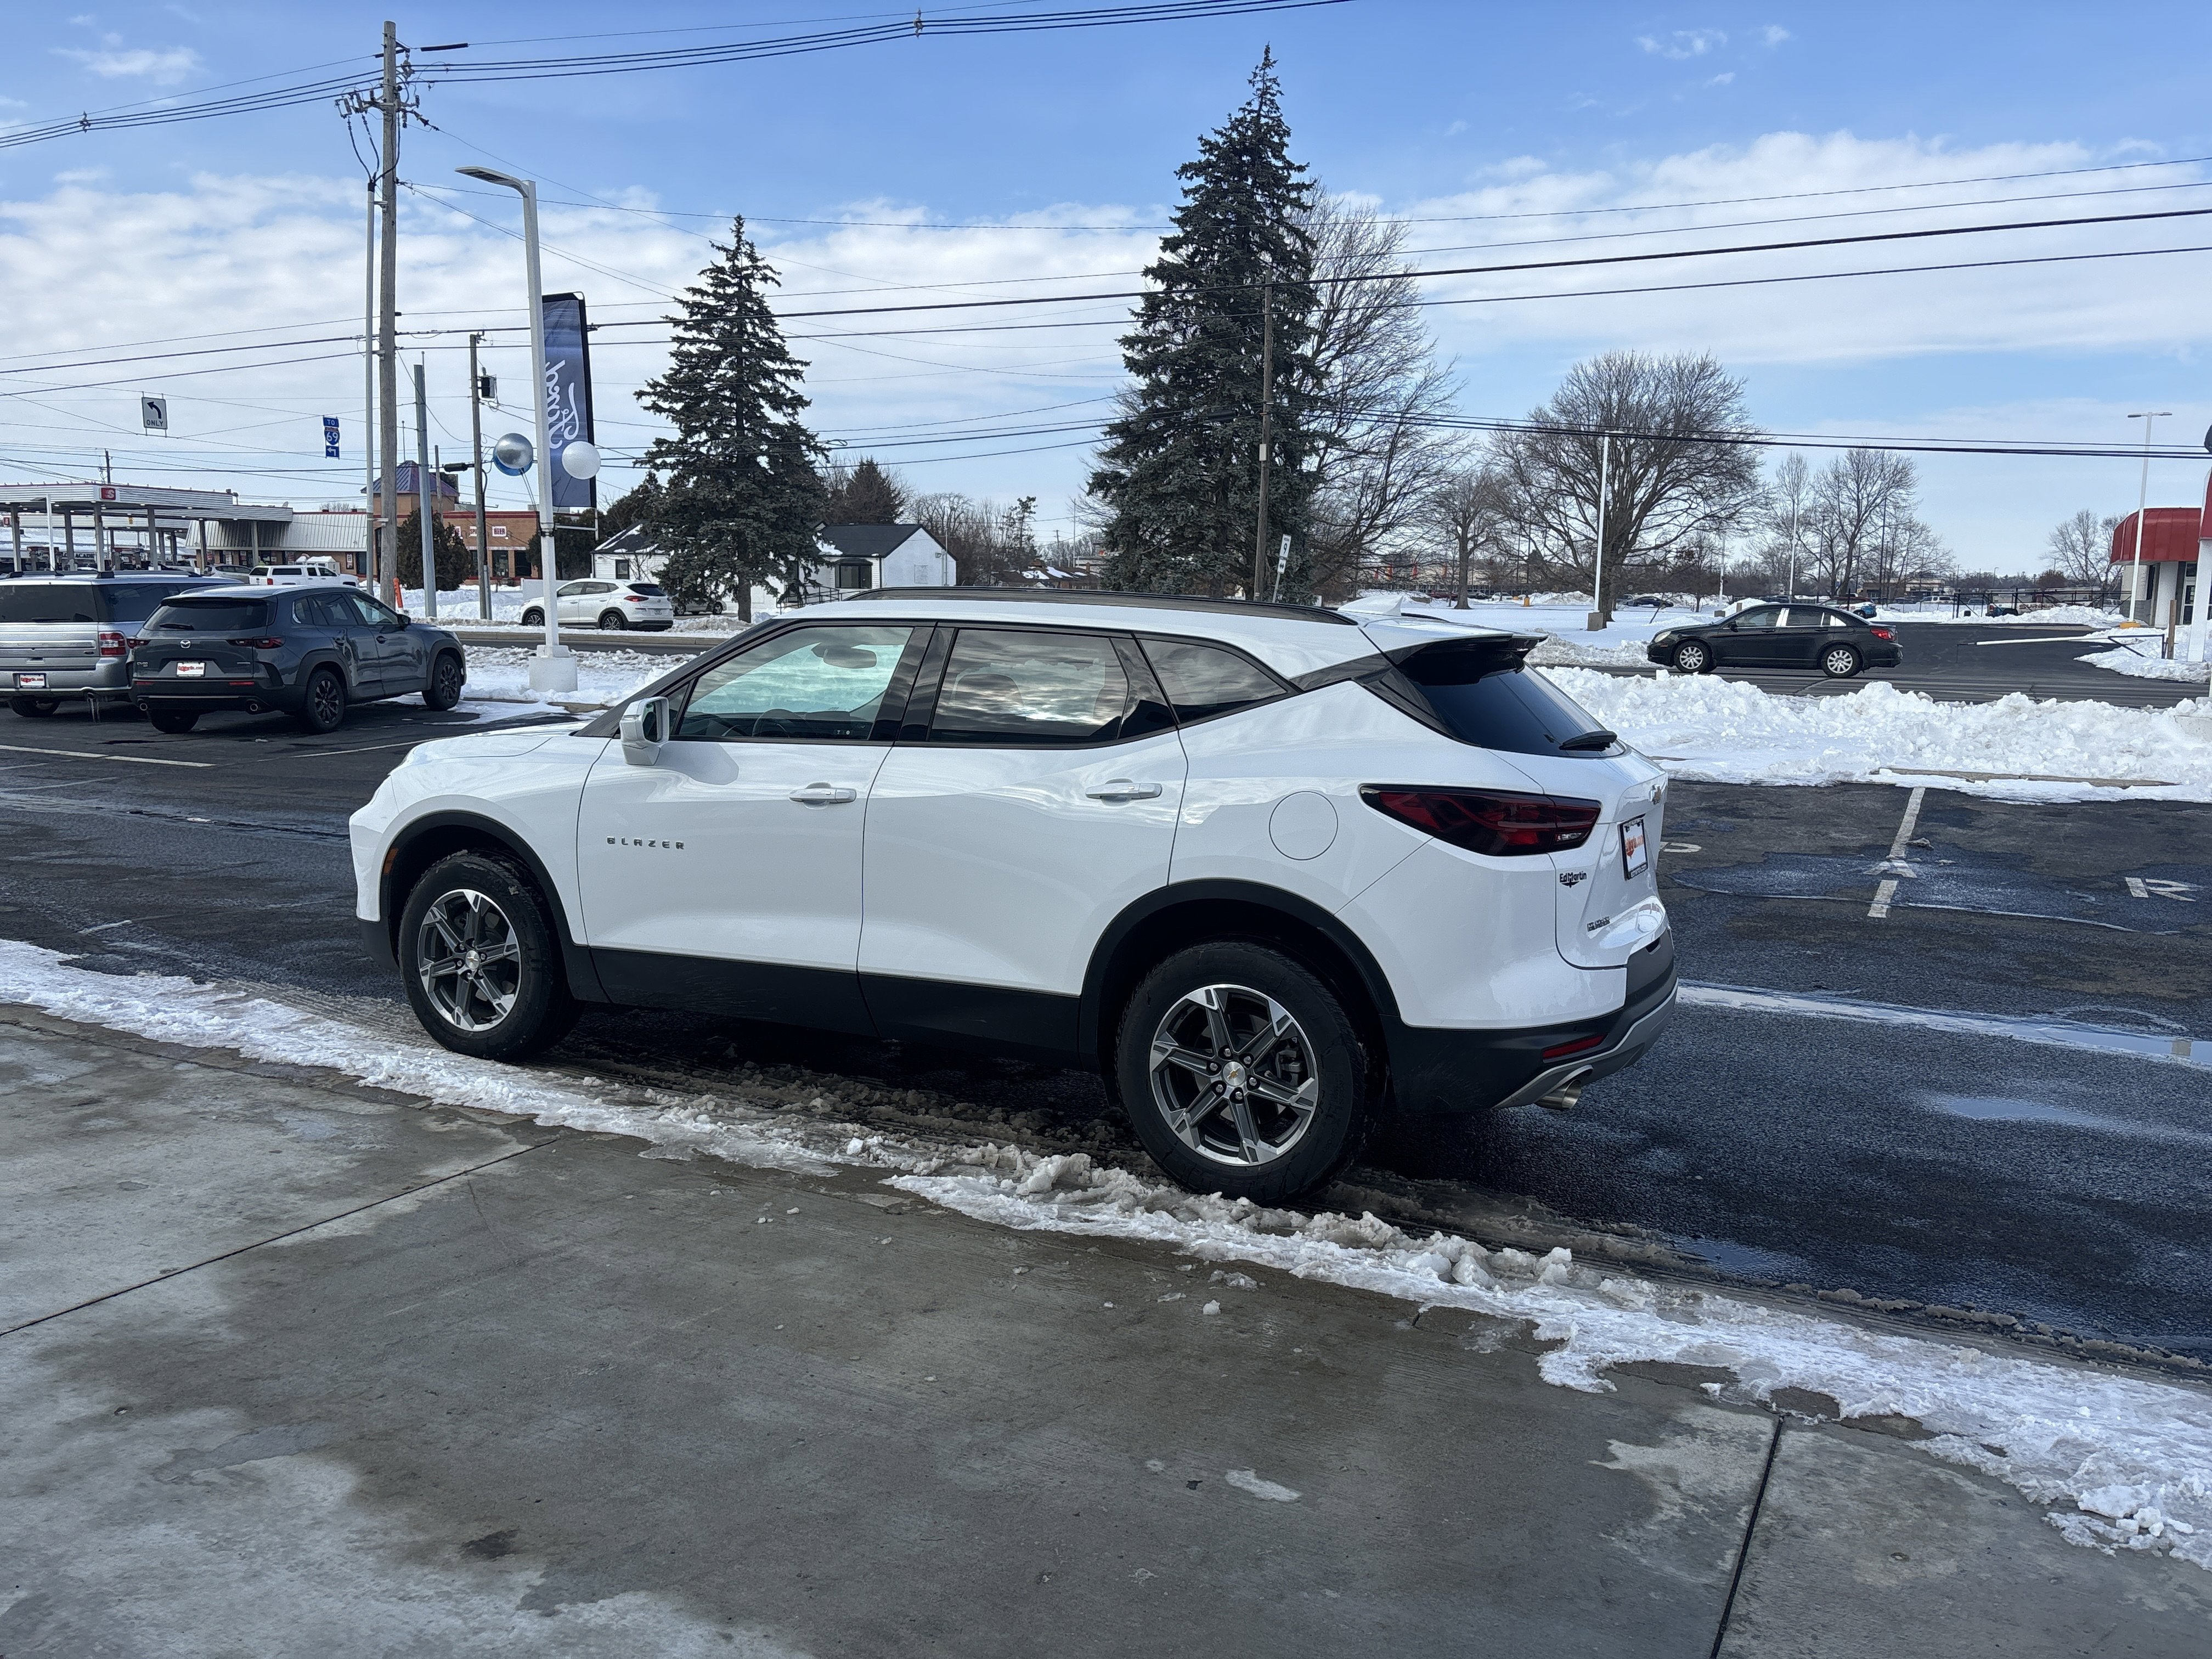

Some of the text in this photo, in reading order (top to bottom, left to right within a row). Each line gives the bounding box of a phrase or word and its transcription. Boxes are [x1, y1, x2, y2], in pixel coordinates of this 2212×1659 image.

[326, 431, 338, 442] 69
[1283, 543, 1288, 555] 9
[606, 836, 685, 850] BLAZER
